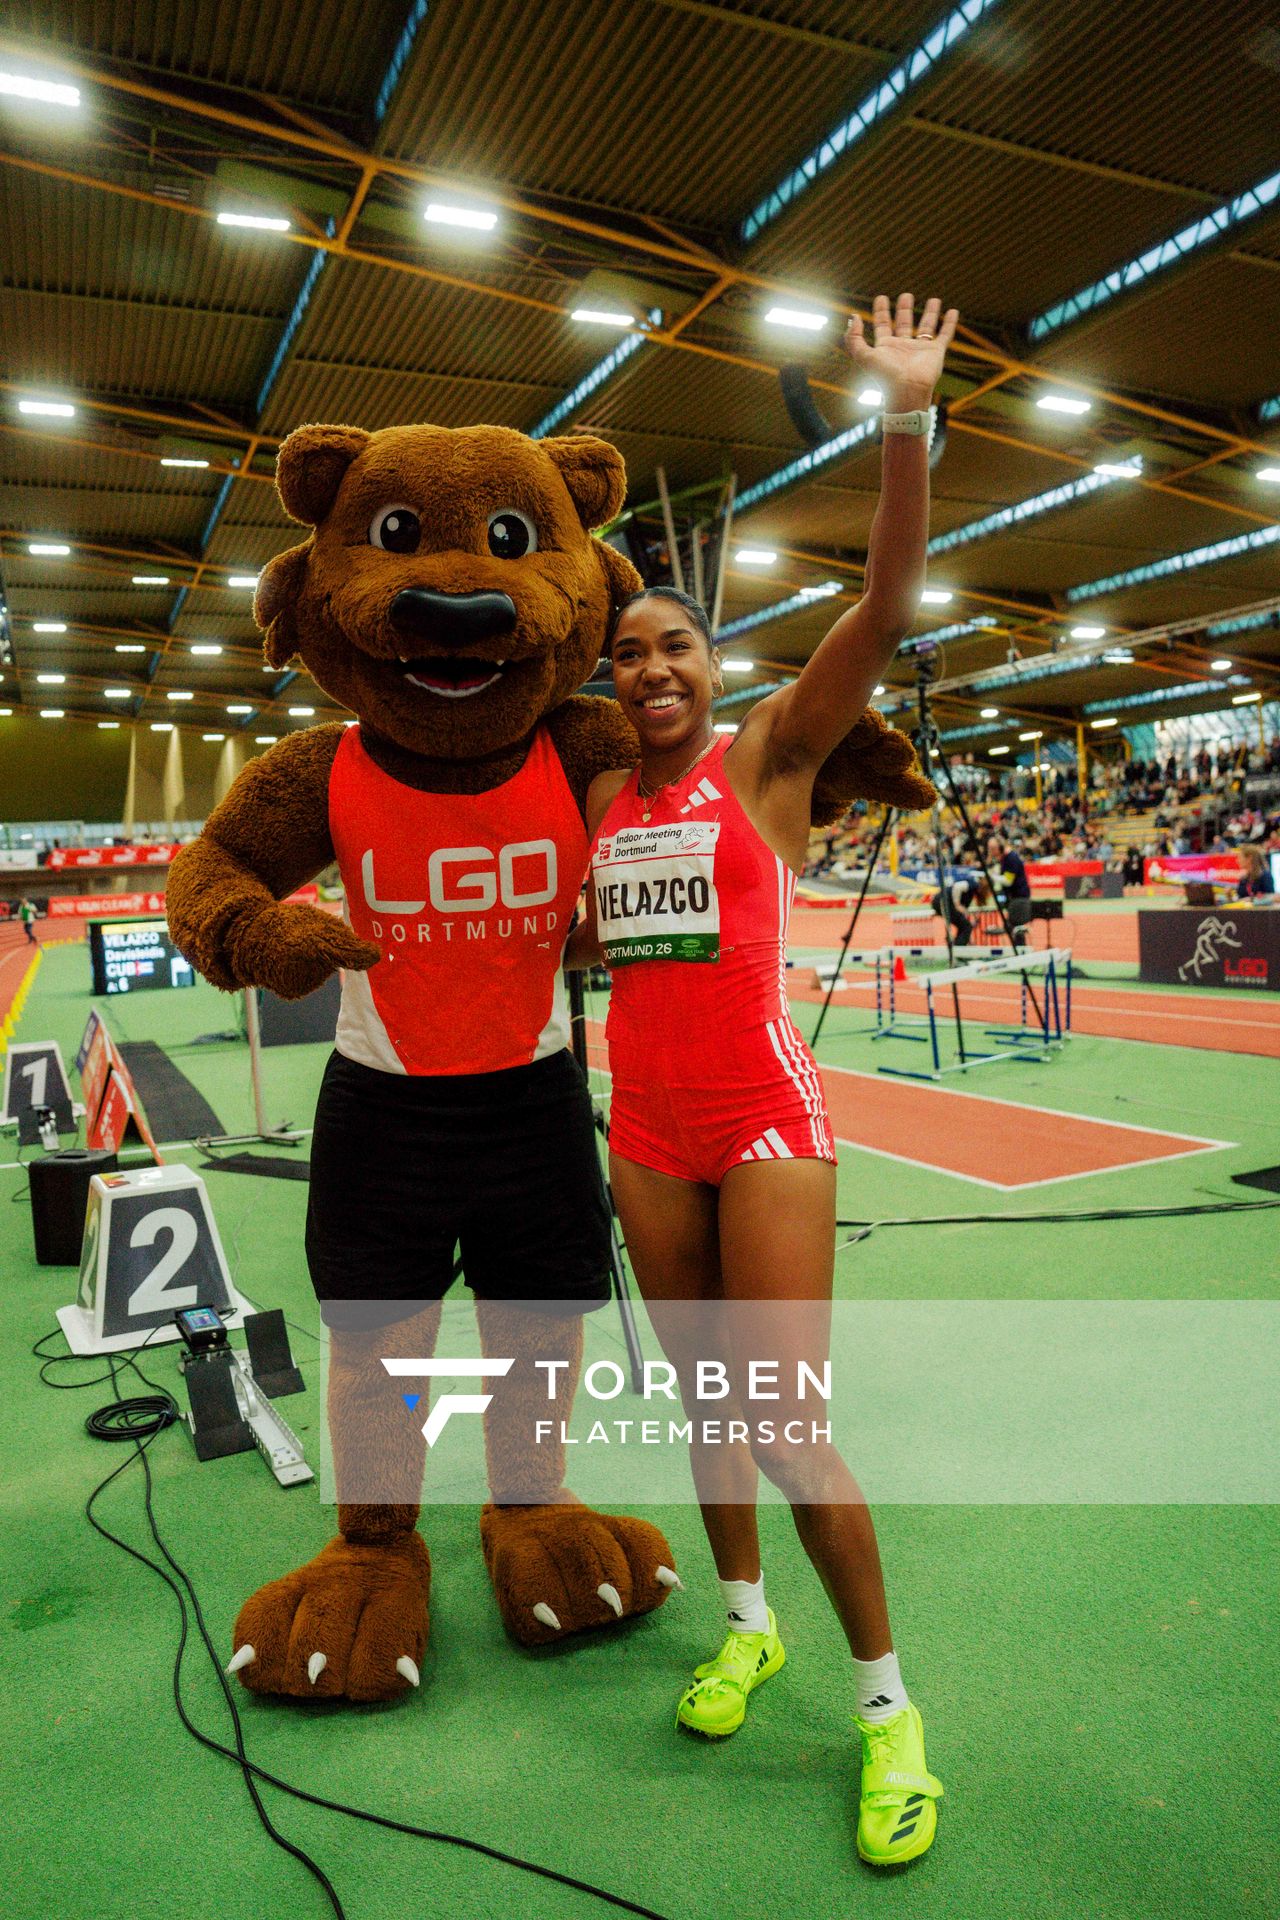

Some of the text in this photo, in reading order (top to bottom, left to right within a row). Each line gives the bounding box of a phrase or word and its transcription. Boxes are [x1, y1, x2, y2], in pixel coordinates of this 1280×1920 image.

[614, 843, 657, 858] Dortmund
[616, 828, 682, 845] Indoor Meeting
[361, 838, 558, 915] LGO
[598, 876, 709, 921] VELAZCO
[371, 911, 558, 943] DORTMUND
[656, 943, 672, 954] 26
[22, 1057, 48, 1105] 1
[127, 1207, 198, 1316] 2
